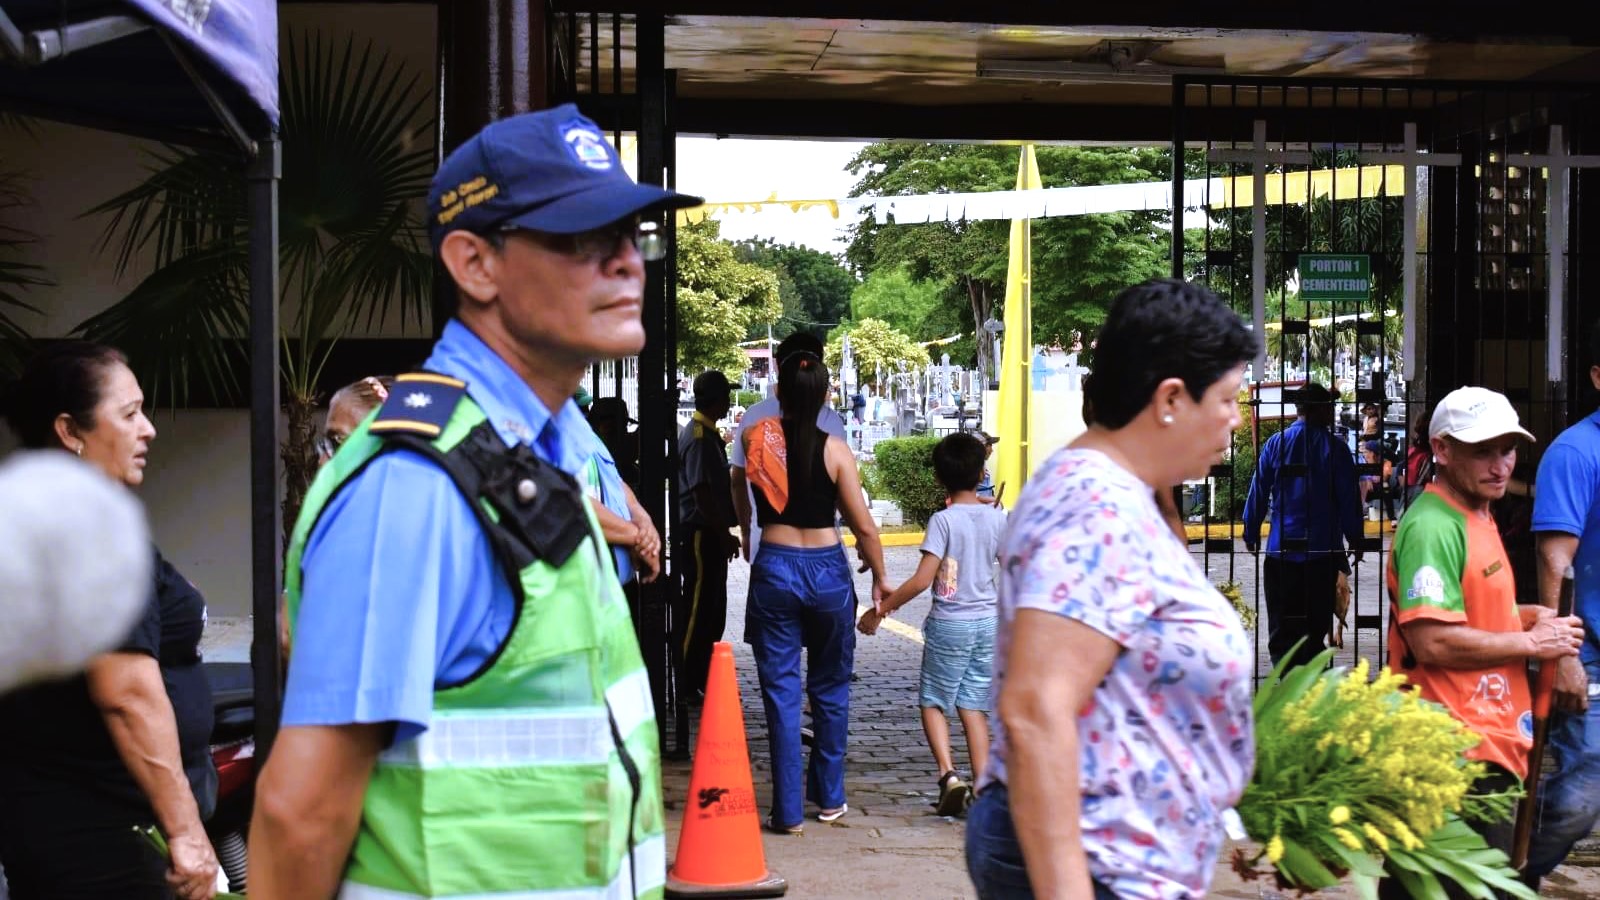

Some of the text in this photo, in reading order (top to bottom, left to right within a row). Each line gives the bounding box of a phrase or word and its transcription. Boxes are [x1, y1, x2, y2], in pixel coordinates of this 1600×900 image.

[1310, 260, 1359, 272] PORTON 1
[1303, 278, 1367, 291] CEMENTERIO
